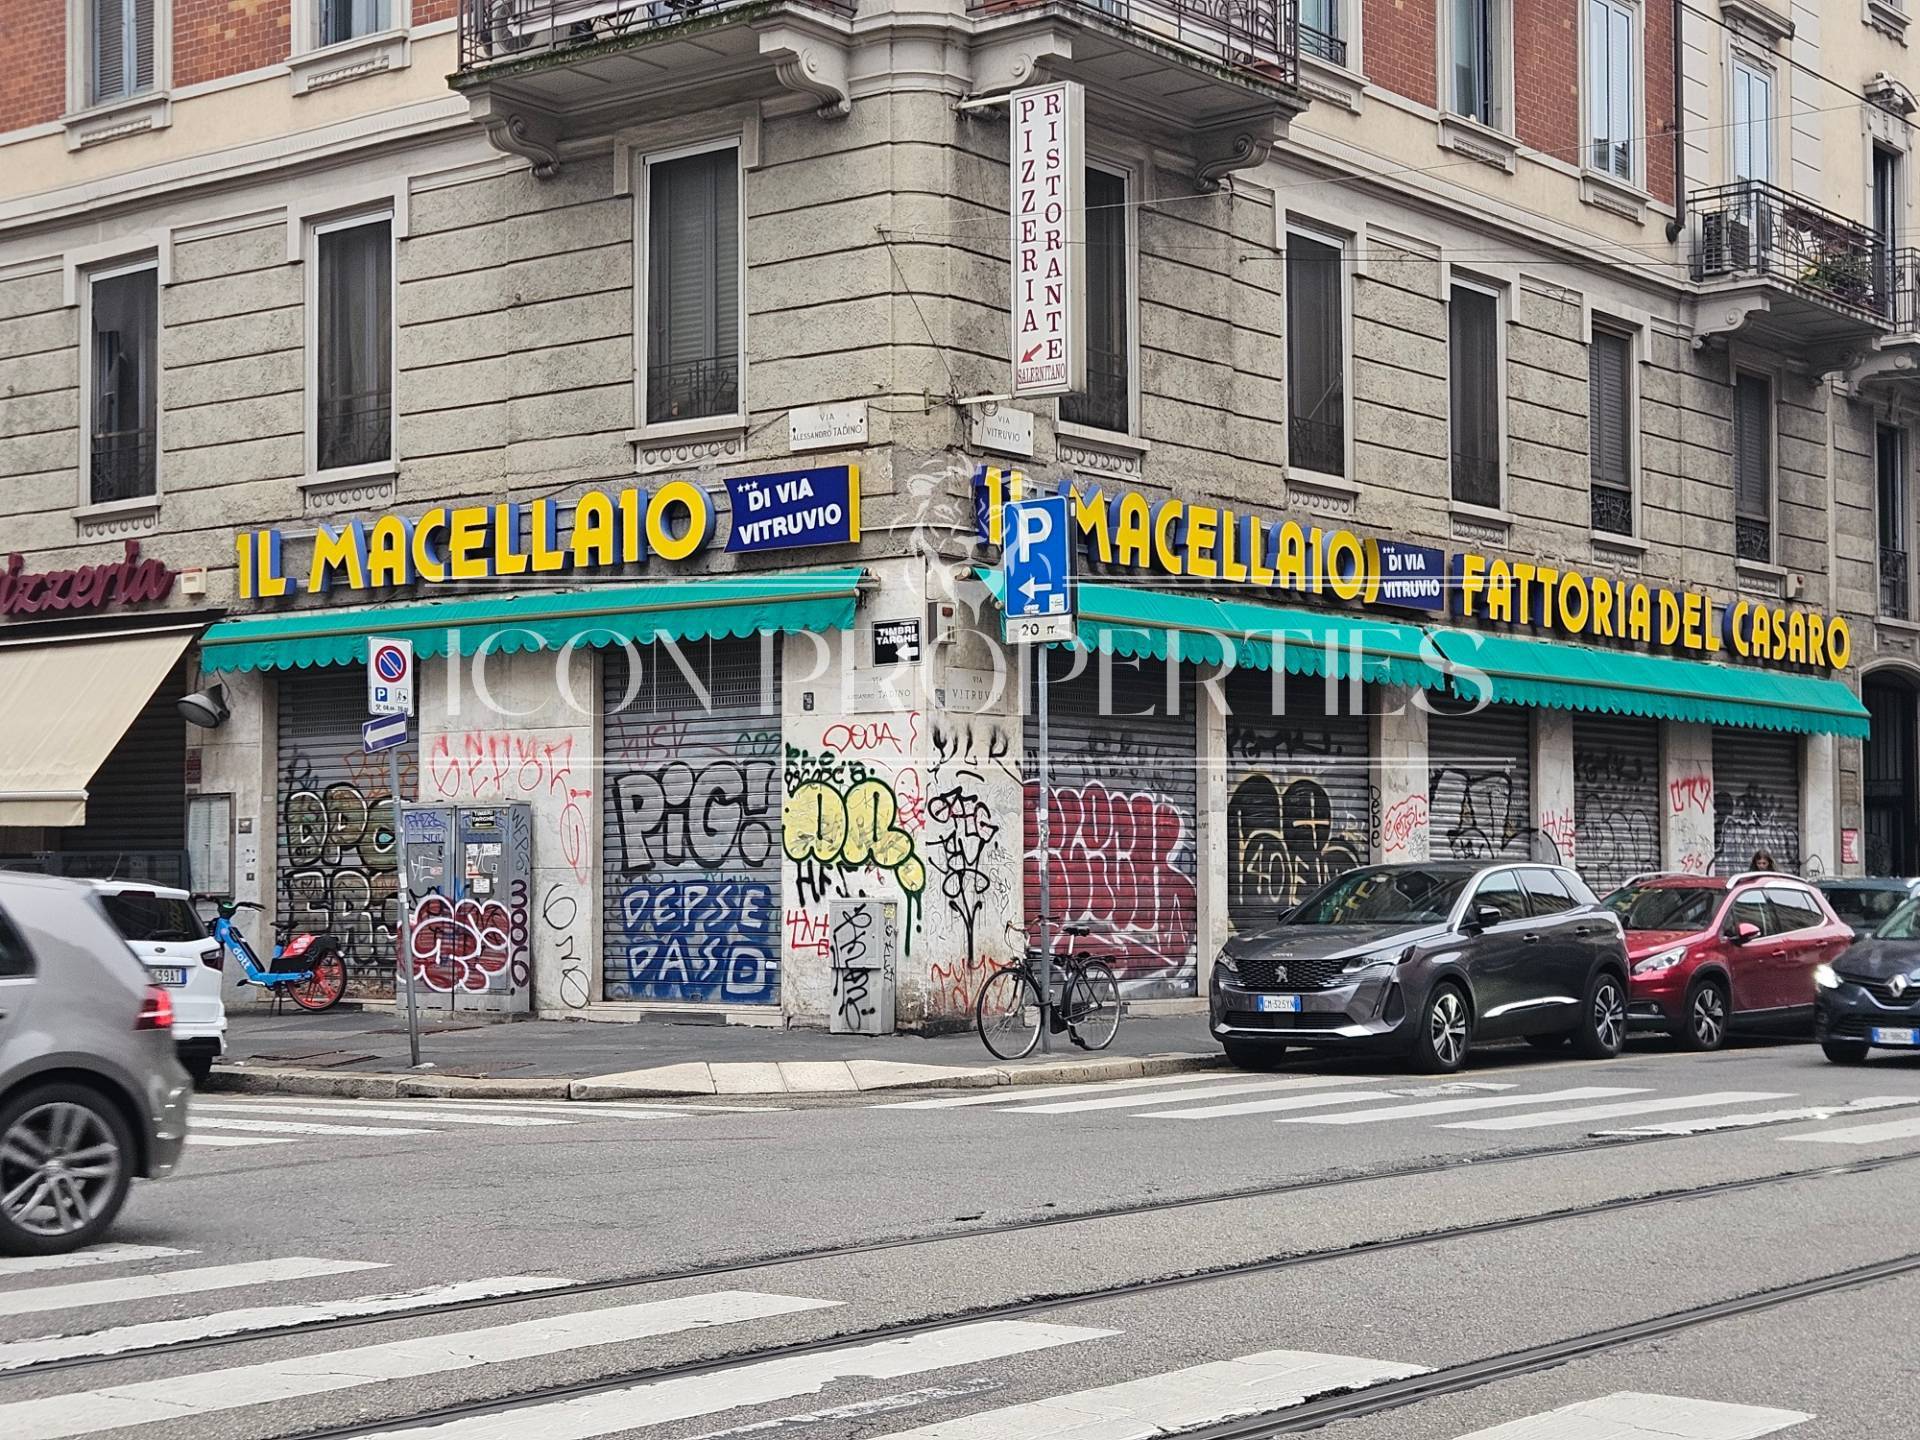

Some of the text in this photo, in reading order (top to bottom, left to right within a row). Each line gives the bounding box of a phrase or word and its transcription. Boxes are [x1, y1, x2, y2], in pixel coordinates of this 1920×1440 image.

[1020, 99, 1038, 333] PIZZERIA
[1043, 93, 1063, 361] RISTORANTE
[1017, 363, 1065, 385] SALERNITANO
[820, 414, 835, 422] VIA
[998, 415, 1010, 424] VIA
[792, 424, 862, 441] ALESSANDRO TADINO
[986, 428, 1020, 442] VITRUVIO
[749, 477, 814, 512] DI VIA
[738, 503, 842, 545] VITRUVIO
[236, 480, 712, 599] IL MACELLAIO
[1019, 508, 1053, 563] P
[1069, 483, 1366, 600] MACELLAIO
[1388, 553, 1426, 573] DI VIA
[0, 538, 177, 614] izzeria
[1383, 579, 1440, 599] VITRUVIO
[1461, 554, 1851, 669] FATTORIA DEL CASARO
[876, 633, 919, 645] TARGHE
[878, 625, 916, 637] TIMBRI
[1022, 623, 1040, 636] 20
[972, 676, 983, 684] VIA
[233, 947, 250, 970] dott
